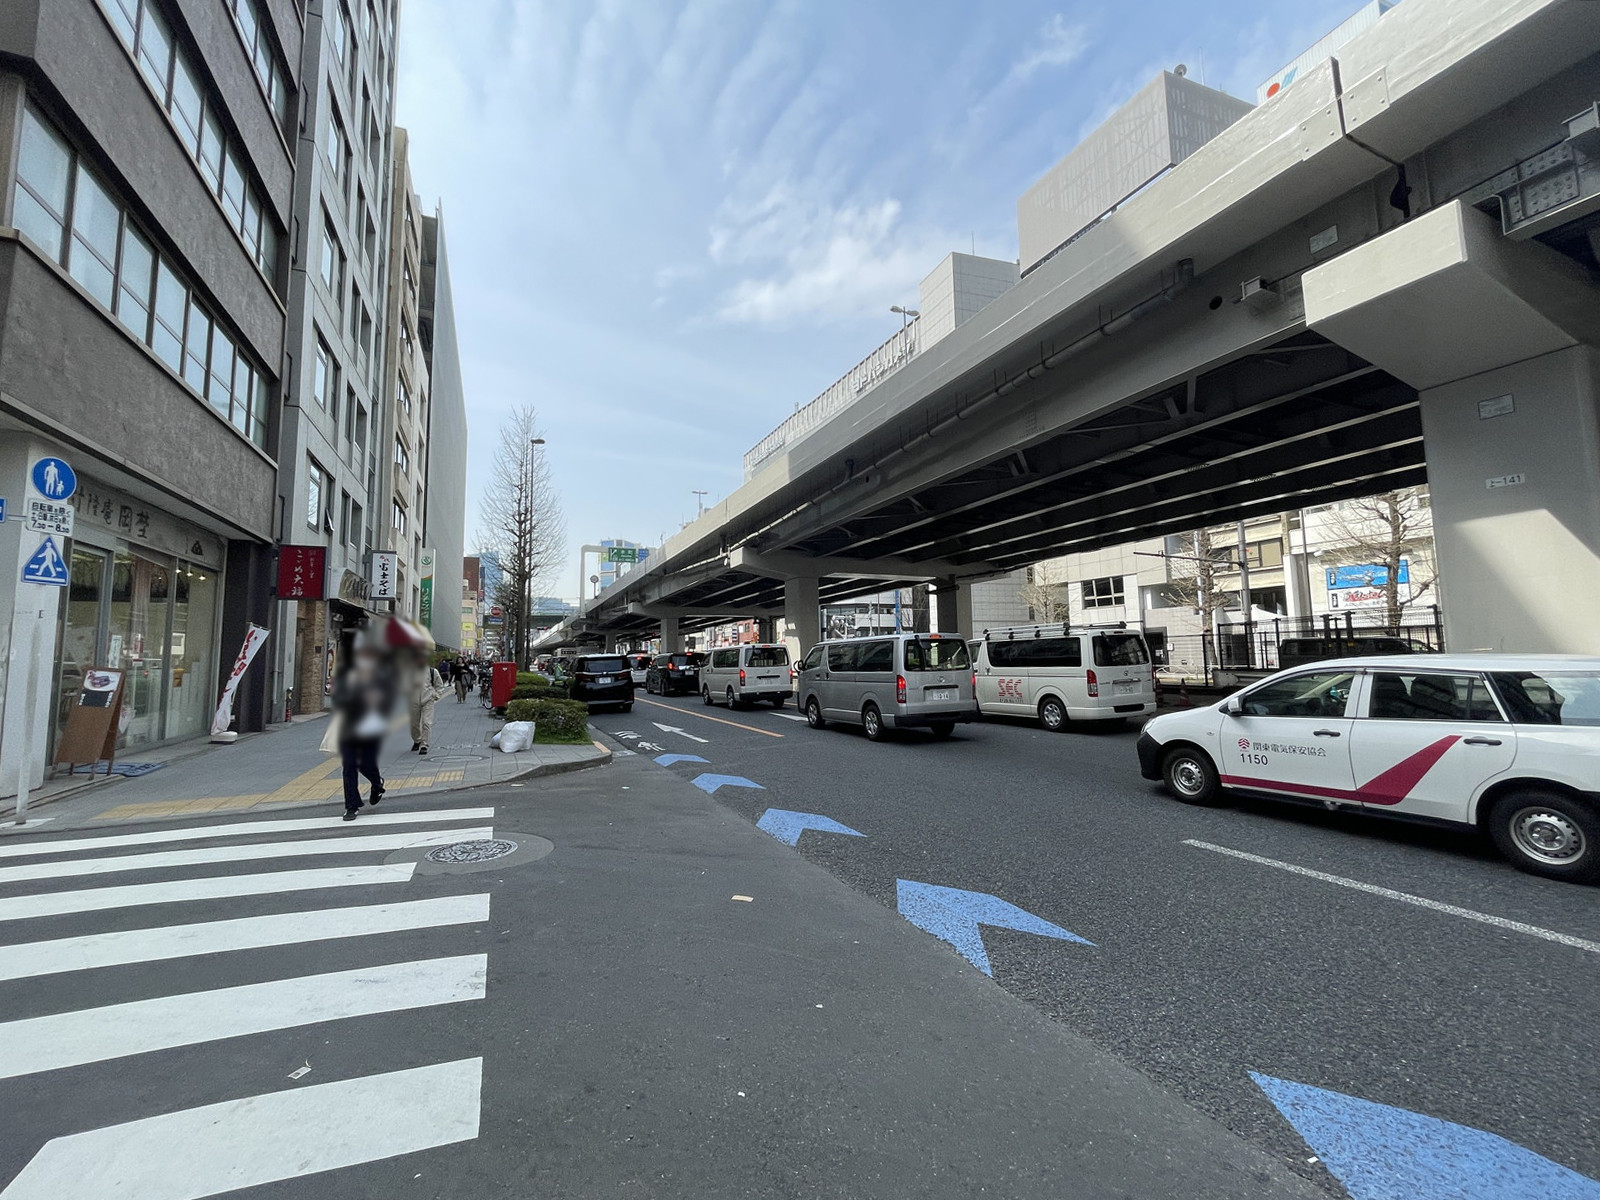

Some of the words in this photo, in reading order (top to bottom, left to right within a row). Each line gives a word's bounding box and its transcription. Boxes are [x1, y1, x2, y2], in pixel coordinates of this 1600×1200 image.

[378, 562, 390, 596] 富士そば
[1253, 742, 1327, 757] 関東電気保安協会
[1240, 753, 1269, 766] 1150
